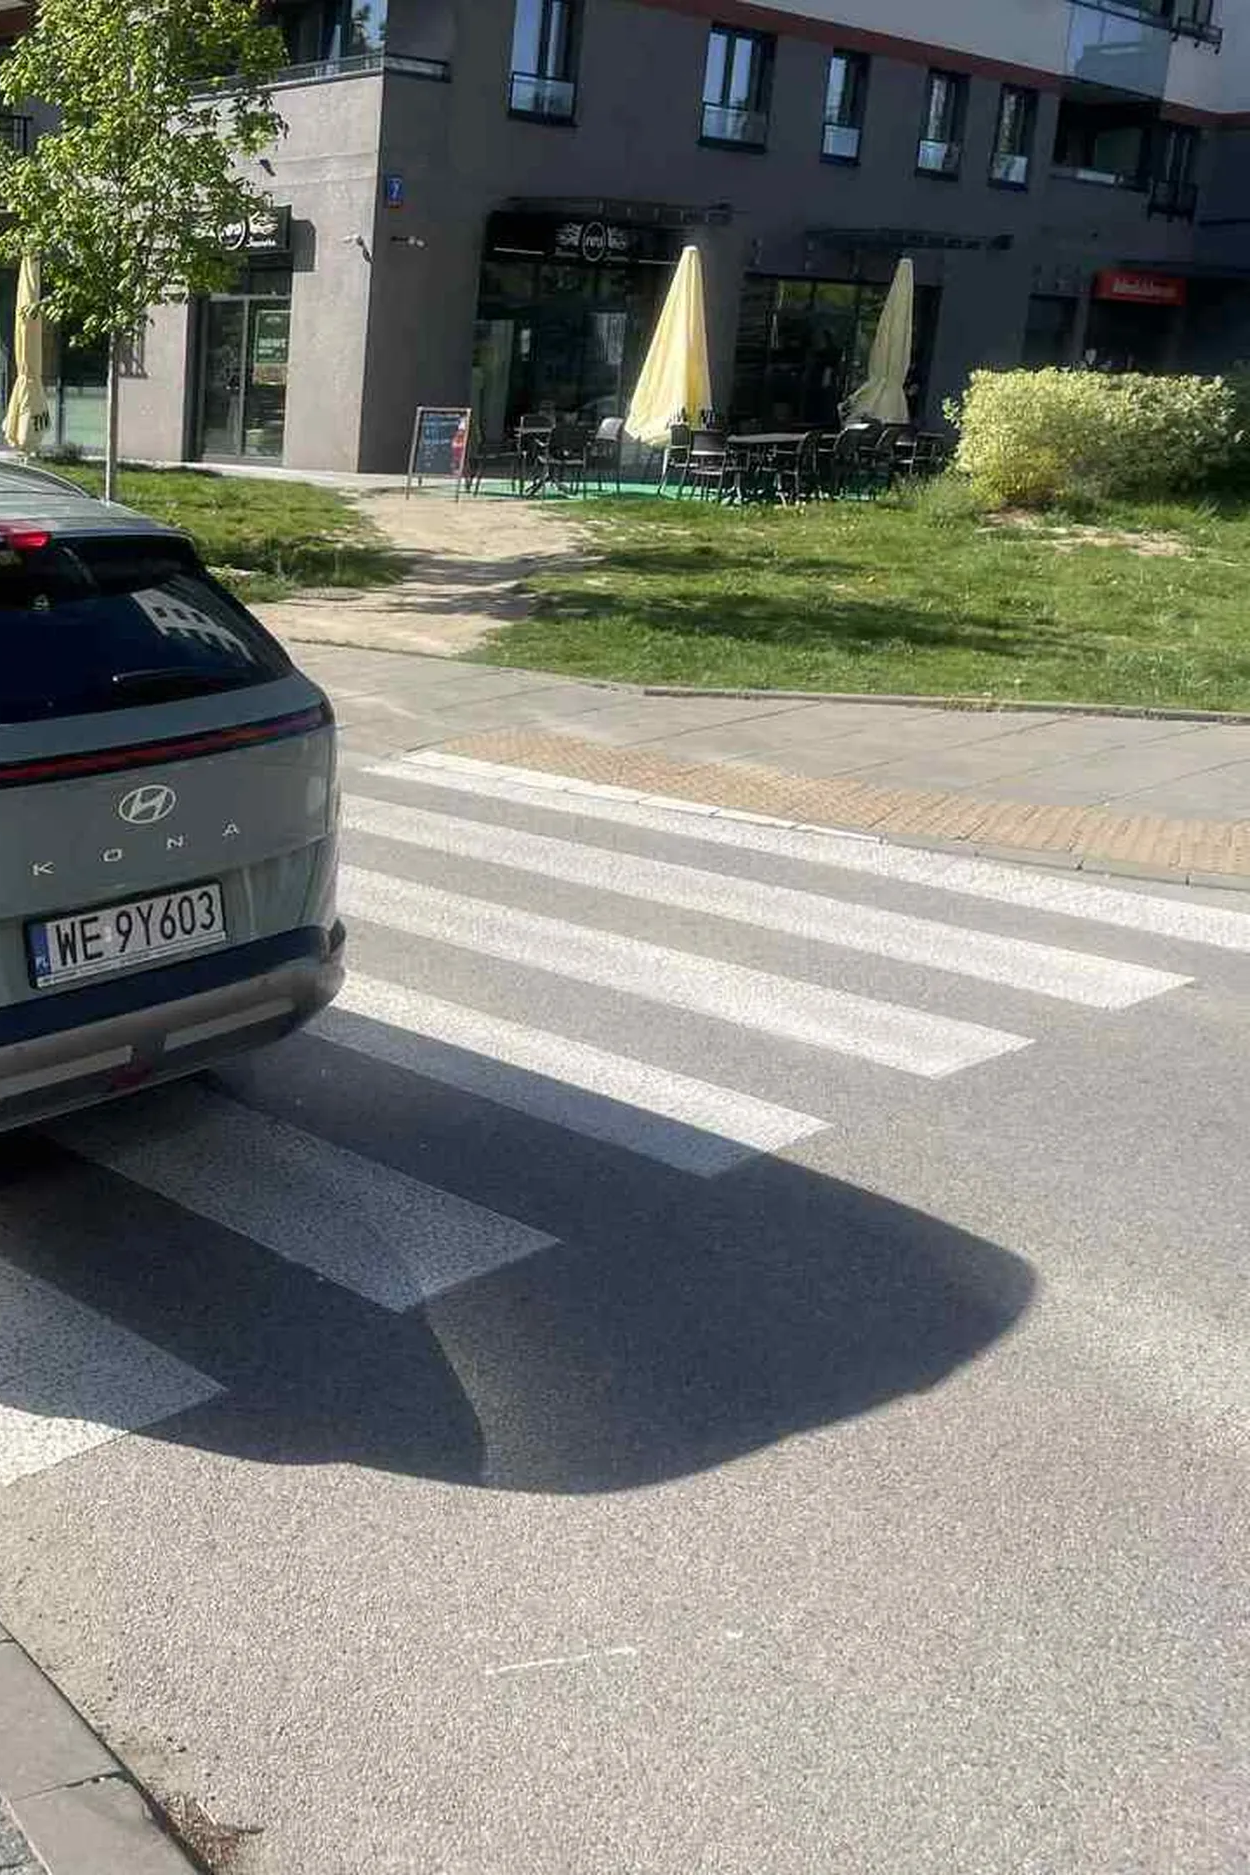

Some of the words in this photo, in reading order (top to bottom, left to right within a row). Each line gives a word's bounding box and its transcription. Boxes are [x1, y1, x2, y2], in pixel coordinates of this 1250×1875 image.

[31, 823, 240, 876] KONA
[55, 916, 104, 966] WE
[115, 891, 216, 953] 9Y603
